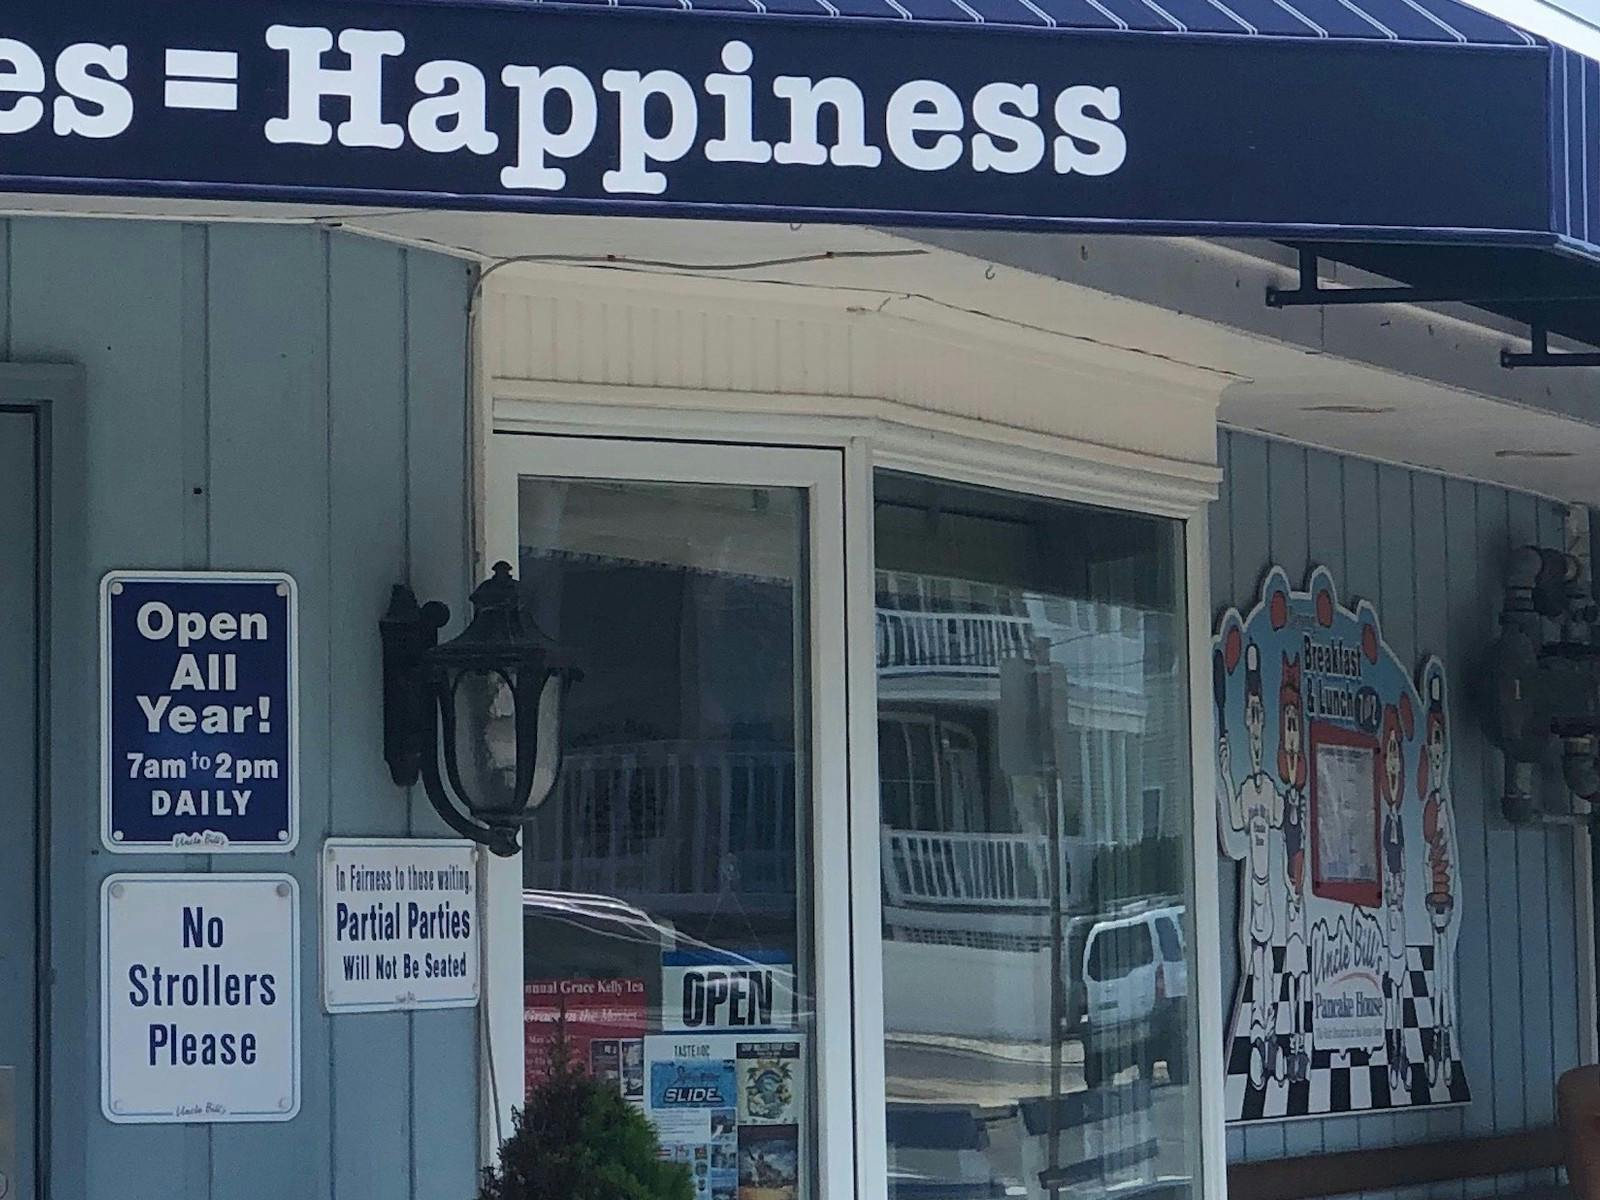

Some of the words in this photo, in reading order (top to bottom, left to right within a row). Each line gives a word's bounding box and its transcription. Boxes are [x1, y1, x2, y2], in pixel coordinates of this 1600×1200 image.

[264, 24, 1127, 195] Happiness
[136, 601, 268, 647] Open
[169, 653, 237, 690] All
[1303, 634, 1362, 677] Breakfast
[136, 695, 271, 734] Year!
[1307, 678, 1314, 713] &
[1318, 678, 1354, 717] Lunch
[127, 752, 187, 779] 7am
[191, 750, 211, 770] to
[215, 752, 279, 783] 2pm
[151, 789, 251, 816] DAILY
[336, 864, 346, 891] In
[351, 864, 392, 892] Fairness
[395, 864, 405, 891] to
[408, 864, 434, 891] those
[183, 907, 224, 948] No
[336, 901, 401, 941] Partial
[408, 900, 471, 939] Parties
[343, 954, 370, 981] Will
[376, 954, 398, 980] Not
[403, 953, 420, 979] Be
[425, 952, 467, 979] Seated
[1314, 931, 1351, 987] Uncle
[1354, 919, 1383, 975] Bill's
[128, 963, 277, 1008] Strollers
[525, 981, 558, 994] nnual
[560, 980, 594, 994] Grace
[597, 979, 623, 997] Kelly
[624, 980, 644, 993] Tea
[682, 969, 774, 1028] OPEN
[1315, 992, 1354, 1019] Pancake
[1356, 992, 1383, 1018] House
[148, 1023, 257, 1066] Please
[674, 1044, 696, 1057] TASTE
[663, 1087, 723, 1103] SLIDE
